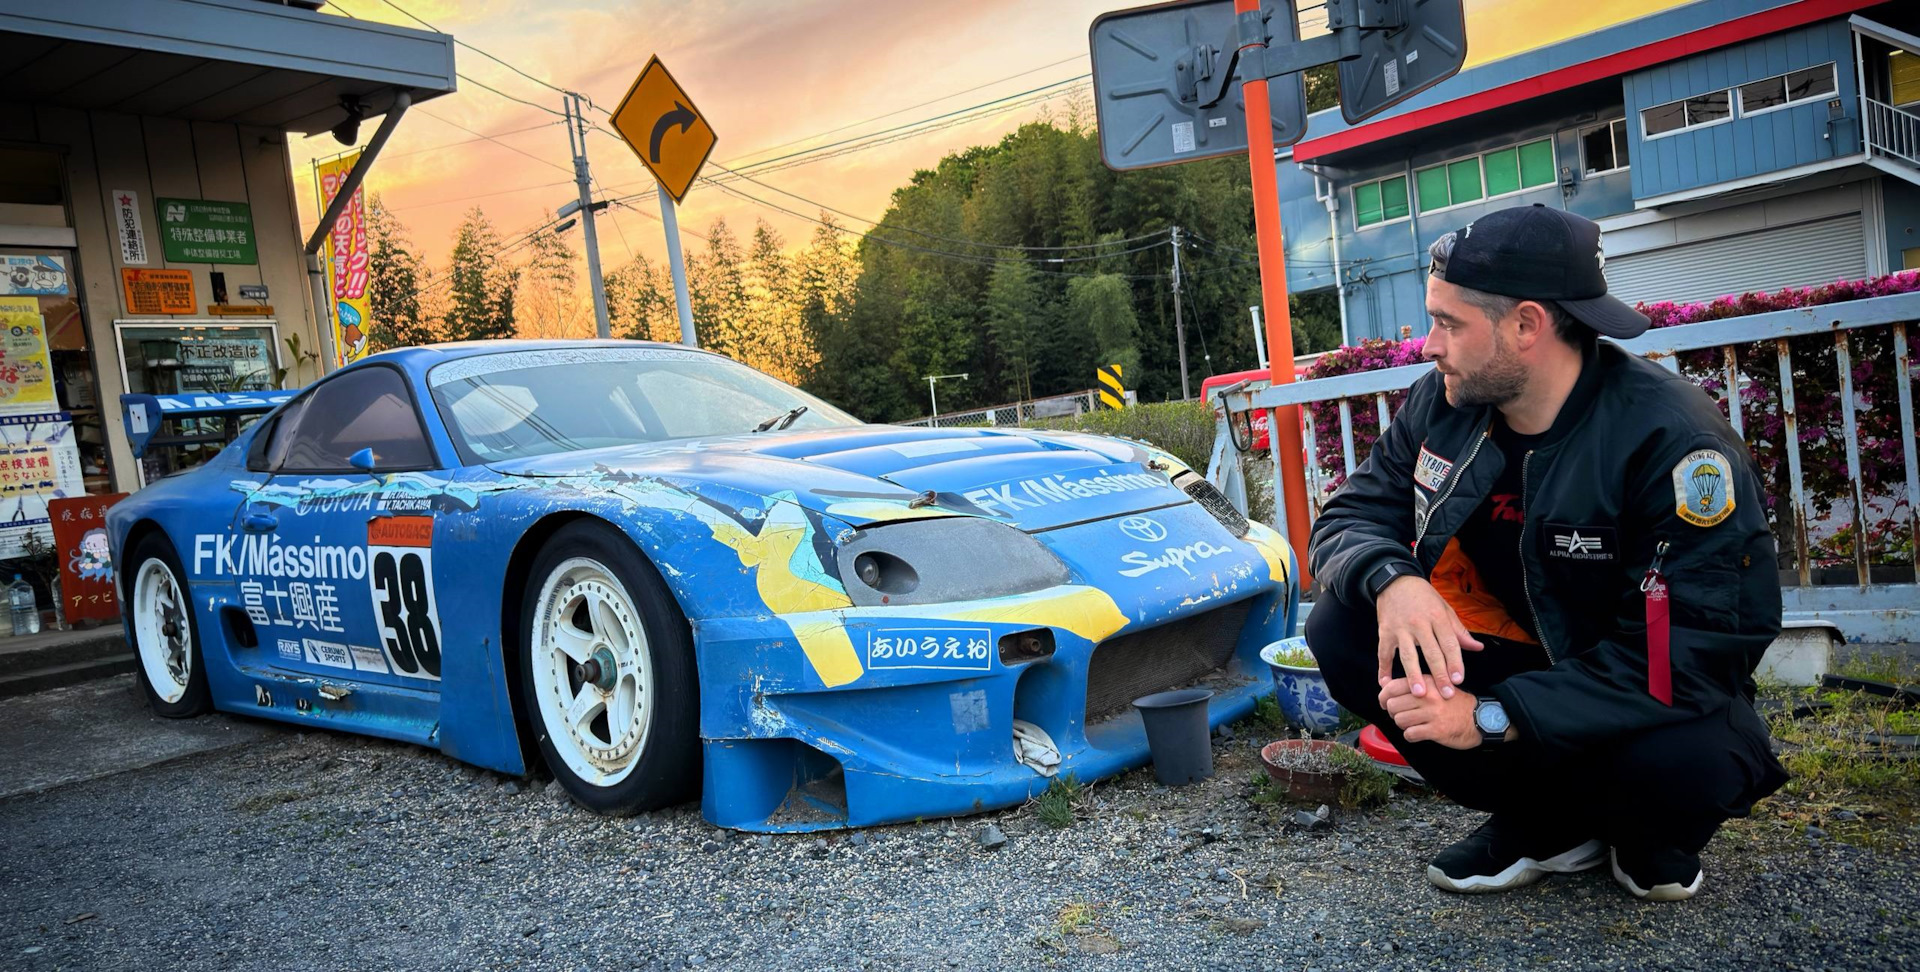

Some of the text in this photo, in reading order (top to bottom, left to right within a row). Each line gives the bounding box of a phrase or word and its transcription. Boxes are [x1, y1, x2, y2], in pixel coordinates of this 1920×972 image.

[122, 207, 140, 261] 防犯連絡所
[170, 227, 247, 245] 特殊整備事業者
[181, 344, 259, 359] 不正改造は
[313, 490, 374, 514] TOYOTA
[385, 499, 432, 511] Y.TACHIKAWA
[381, 523, 432, 540] AUTOBACS
[1118, 540, 1233, 578] Supra
[1549, 550, 1571, 558] ALPHA
[72, 590, 113, 608] アマビ
[241, 578, 345, 633] 富士興産
[373, 551, 442, 677] 38
[278, 641, 301, 654] RAYS
[320, 645, 346, 657] CERUMO
[871, 636, 988, 660] あいうえお
[324, 653, 346, 664] SPORTS
